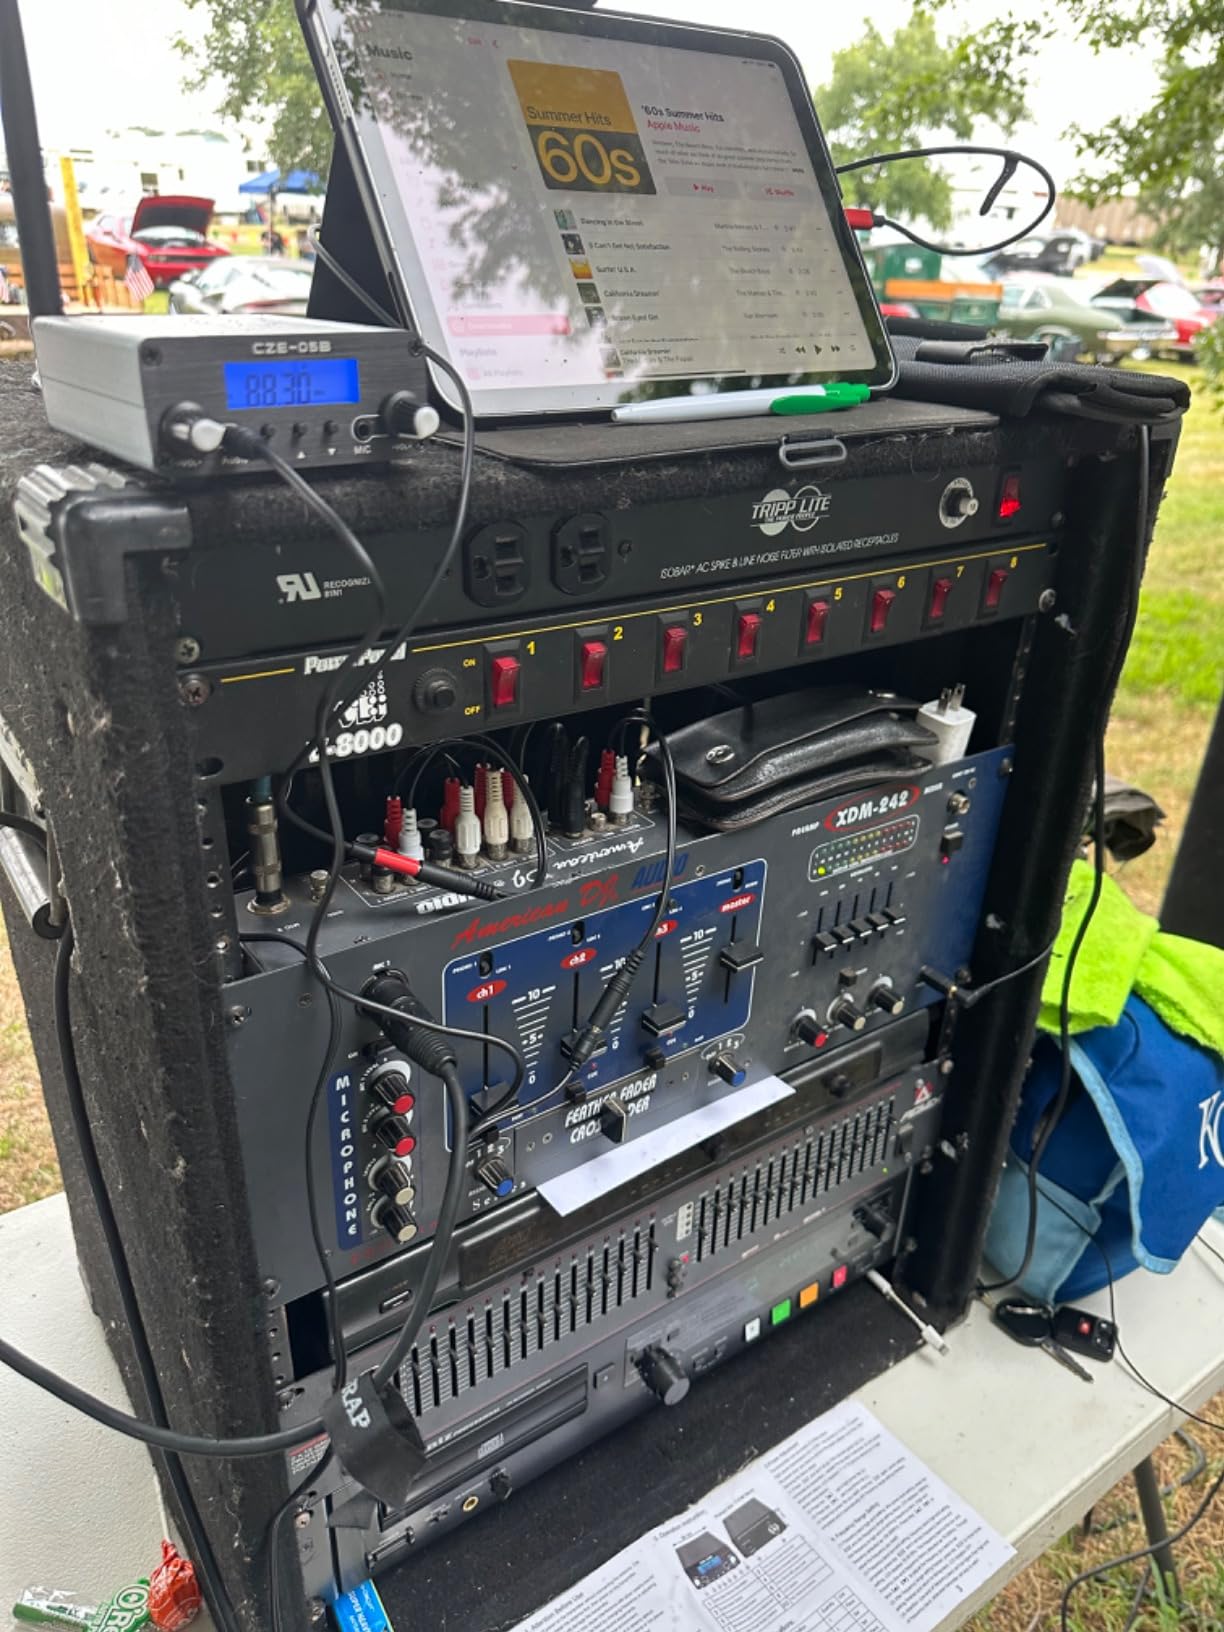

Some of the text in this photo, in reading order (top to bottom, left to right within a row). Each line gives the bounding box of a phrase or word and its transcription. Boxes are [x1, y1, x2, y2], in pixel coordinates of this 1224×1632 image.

[364, 44, 413, 61] Music
[526, 105, 612, 127] Summer Hits
[665, 106, 703, 120] Summer
[705, 108, 725, 122] Hits
[647, 118, 700, 133] Apple Music
[537, 129, 641, 187] 60s
[253, 340, 332, 355] CZE-05B
[752, 496, 831, 519] TRIPP LITE
[695, 562, 710, 574] AC
[710, 559, 731, 572] SPIKE
[1011, 556, 1018, 569] 8
[956, 565, 964, 579] 7
[323, 577, 371, 589] RECOGNIZ
[898, 575, 906, 589] 6
[834, 586, 842, 601] 5
[766, 599, 776, 613] 4
[693, 612, 703, 627] 3
[613, 626, 624, 641] 2
[527, 641, 536, 656] 1
[463, 657, 476, 668] ON
[464, 704, 481, 716] OFF
[835, 789, 909, 828] XDM-242
[720, 895, 751, 913] master
[451, 898, 569, 950] American
[693, 928, 704, 941] 10
[569, 953, 586, 967] ch2
[691, 971, 698, 982] 5
[476, 985, 494, 1000] ch1
[528, 988, 540, 1001] 10
[529, 1033, 537, 1045] 5
[529, 1075, 536, 1085] 0
[620, 1073, 657, 1101] FADER
[335, 1074, 358, 1236] MICROPHONE
